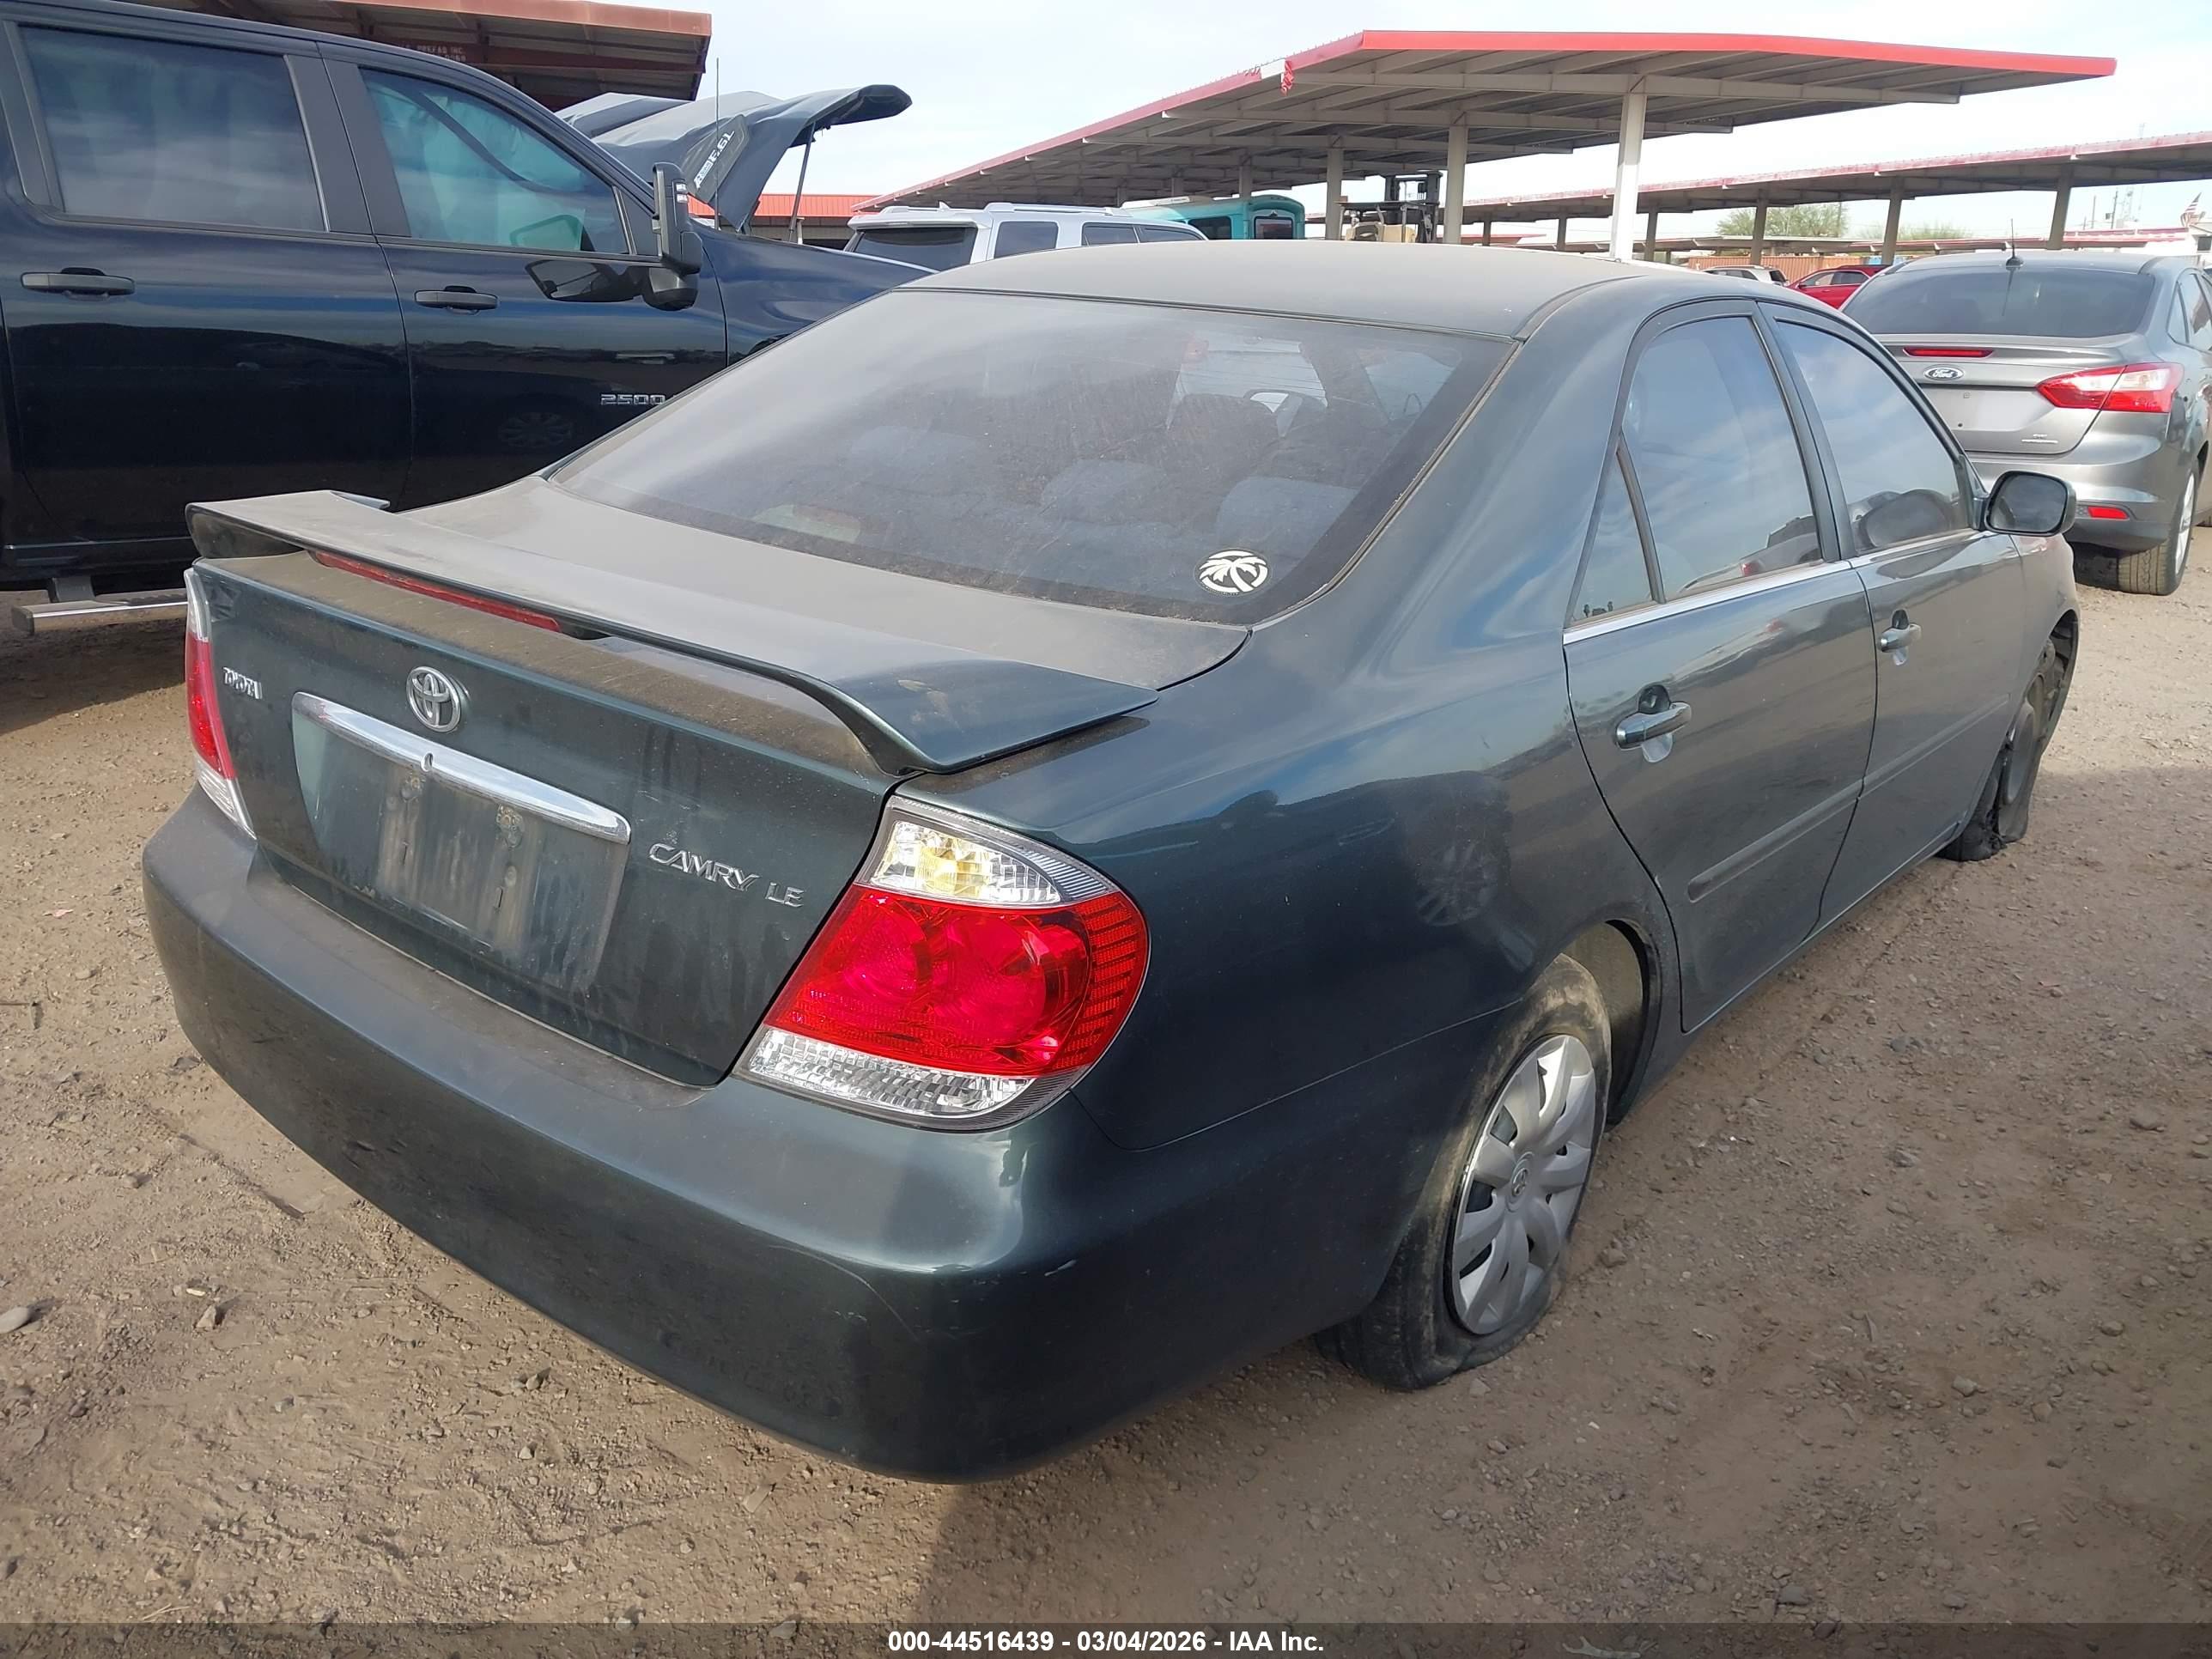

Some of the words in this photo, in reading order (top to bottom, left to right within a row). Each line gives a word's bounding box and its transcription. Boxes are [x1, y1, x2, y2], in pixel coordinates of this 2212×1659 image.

[600, 393, 666, 405] 2500
[222, 666, 263, 700] TOYOTA
[648, 842, 762, 892] CAMRY
[764, 881, 805, 908] LE
